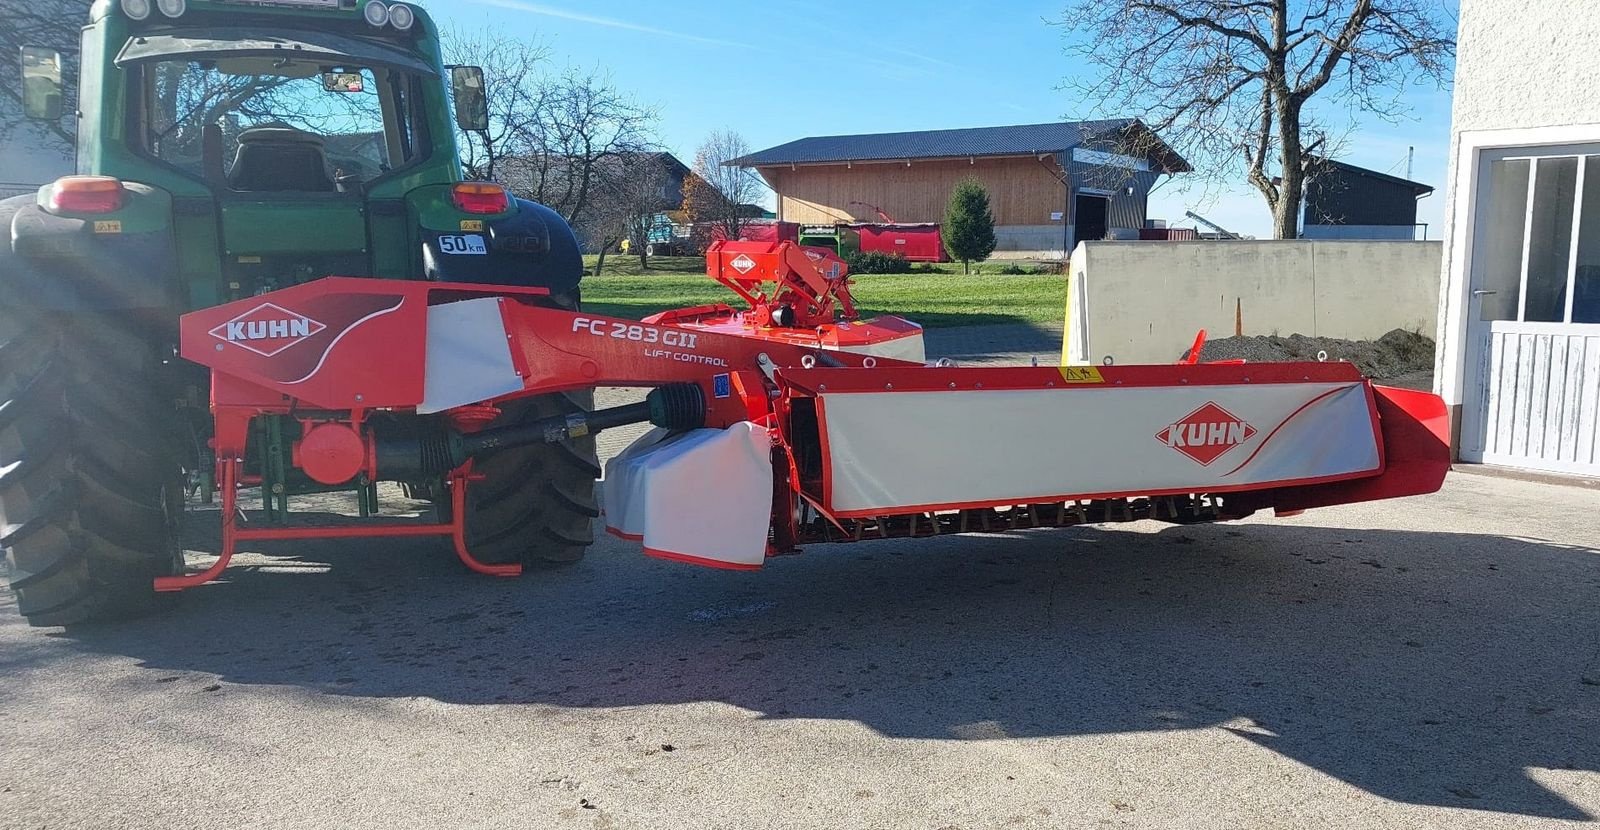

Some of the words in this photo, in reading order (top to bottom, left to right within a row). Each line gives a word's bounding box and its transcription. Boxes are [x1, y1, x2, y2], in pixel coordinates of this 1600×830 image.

[441, 236, 467, 252] 50
[469, 244, 485, 252] km
[227, 319, 310, 341] KUHN
[572, 317, 605, 336] FC
[610, 322, 659, 343] 283
[662, 330, 698, 349] GII
[644, 348, 672, 359] LIFT
[673, 352, 729, 367] CONTROL
[1167, 421, 1247, 447] KUHN
